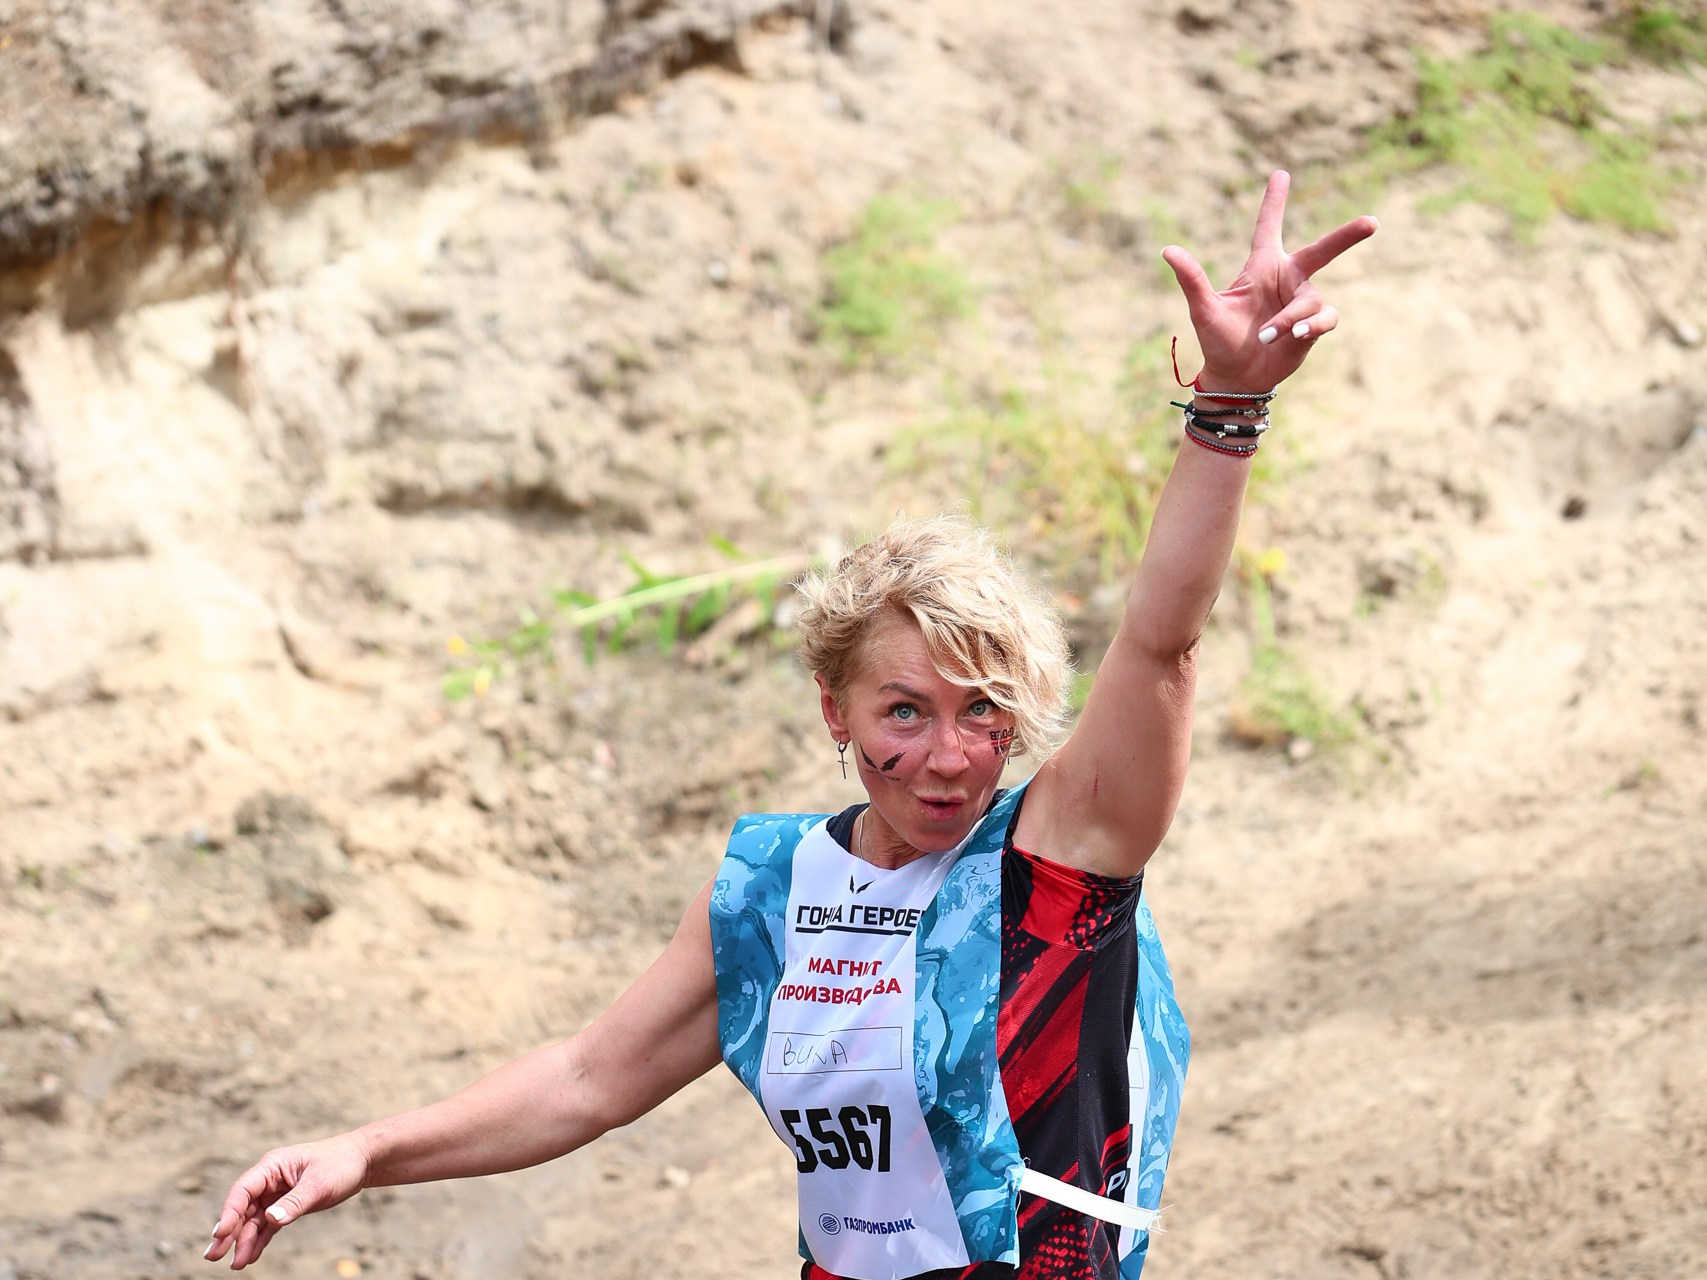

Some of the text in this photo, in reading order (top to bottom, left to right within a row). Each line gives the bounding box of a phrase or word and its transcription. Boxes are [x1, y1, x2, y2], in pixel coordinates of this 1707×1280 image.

[796, 904, 926, 928] ГОНА ГЕРОЕ
[780, 1105, 891, 1174] 5567
[843, 1217, 916, 1235] ГАЗПРОМБАНК
